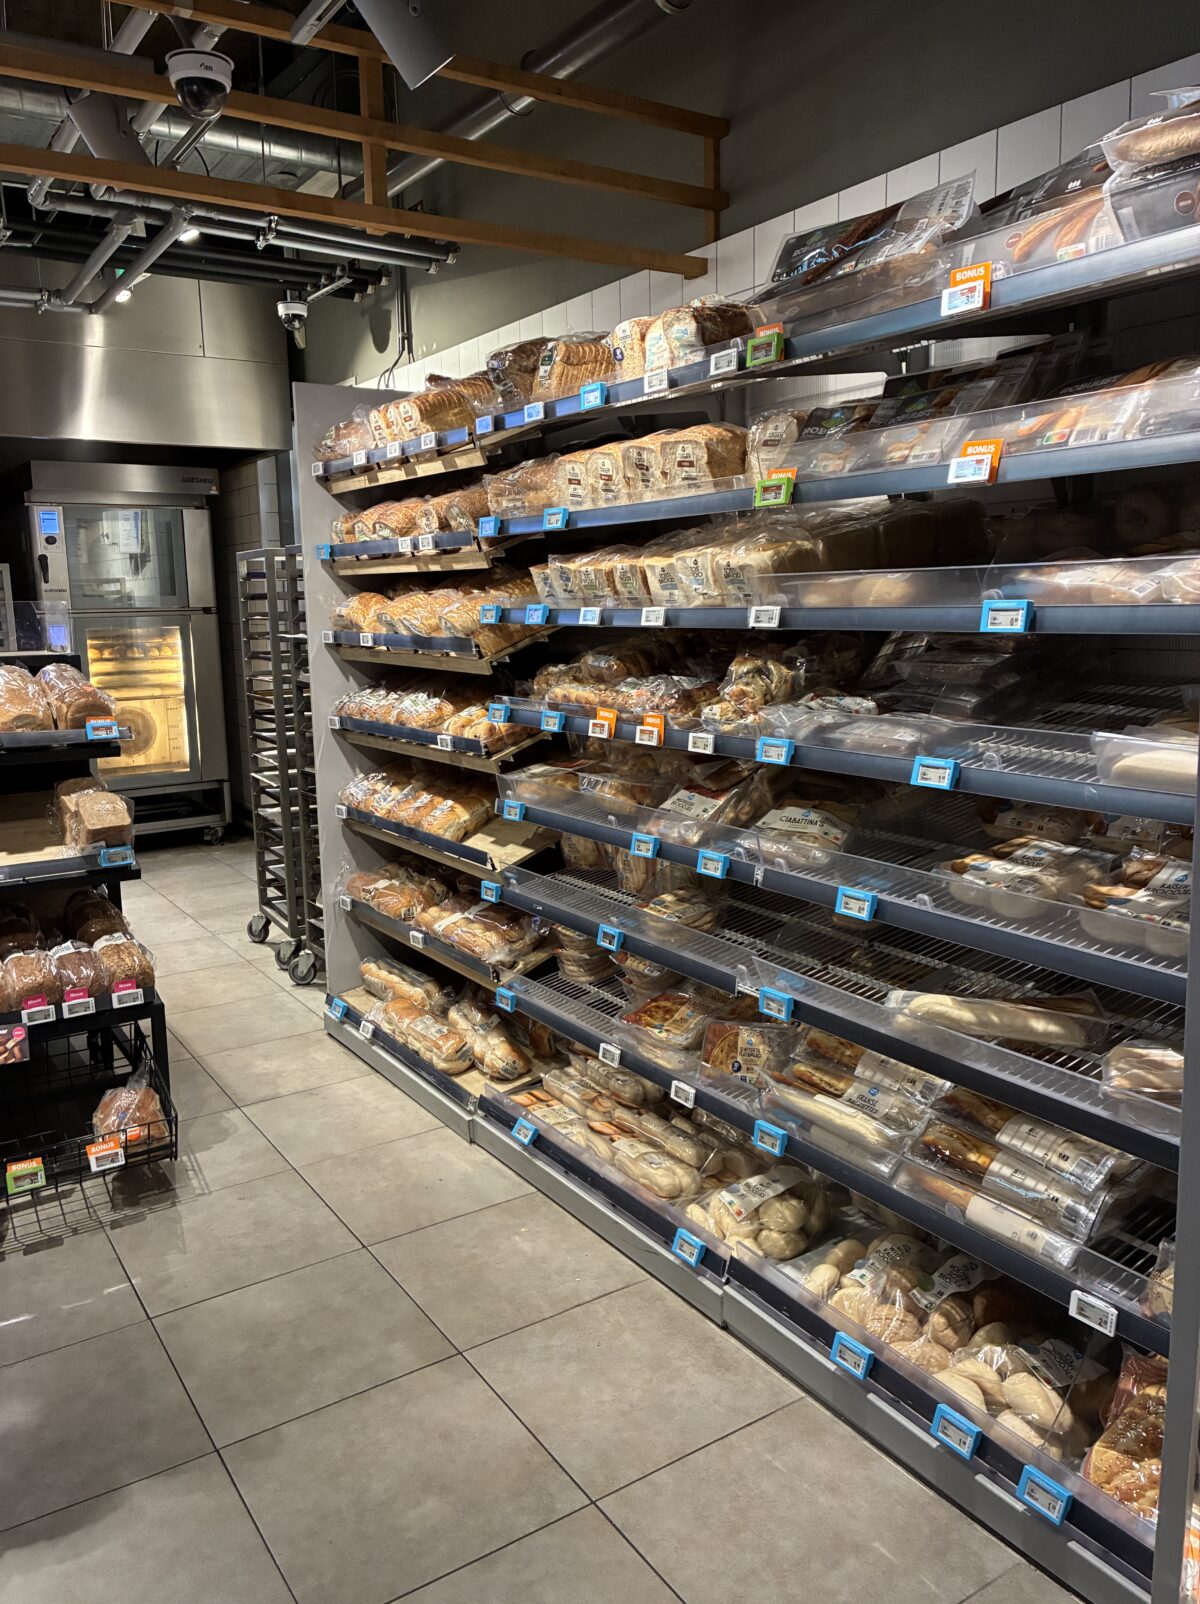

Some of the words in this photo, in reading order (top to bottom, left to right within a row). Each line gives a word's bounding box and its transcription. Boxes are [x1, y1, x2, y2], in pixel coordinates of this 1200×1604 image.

[955, 266, 986, 281] BONUS
[967, 444, 996, 455] BONUS
[91, 1141, 115, 1153] BONUS
[12, 1161, 37, 1172] BONUS
